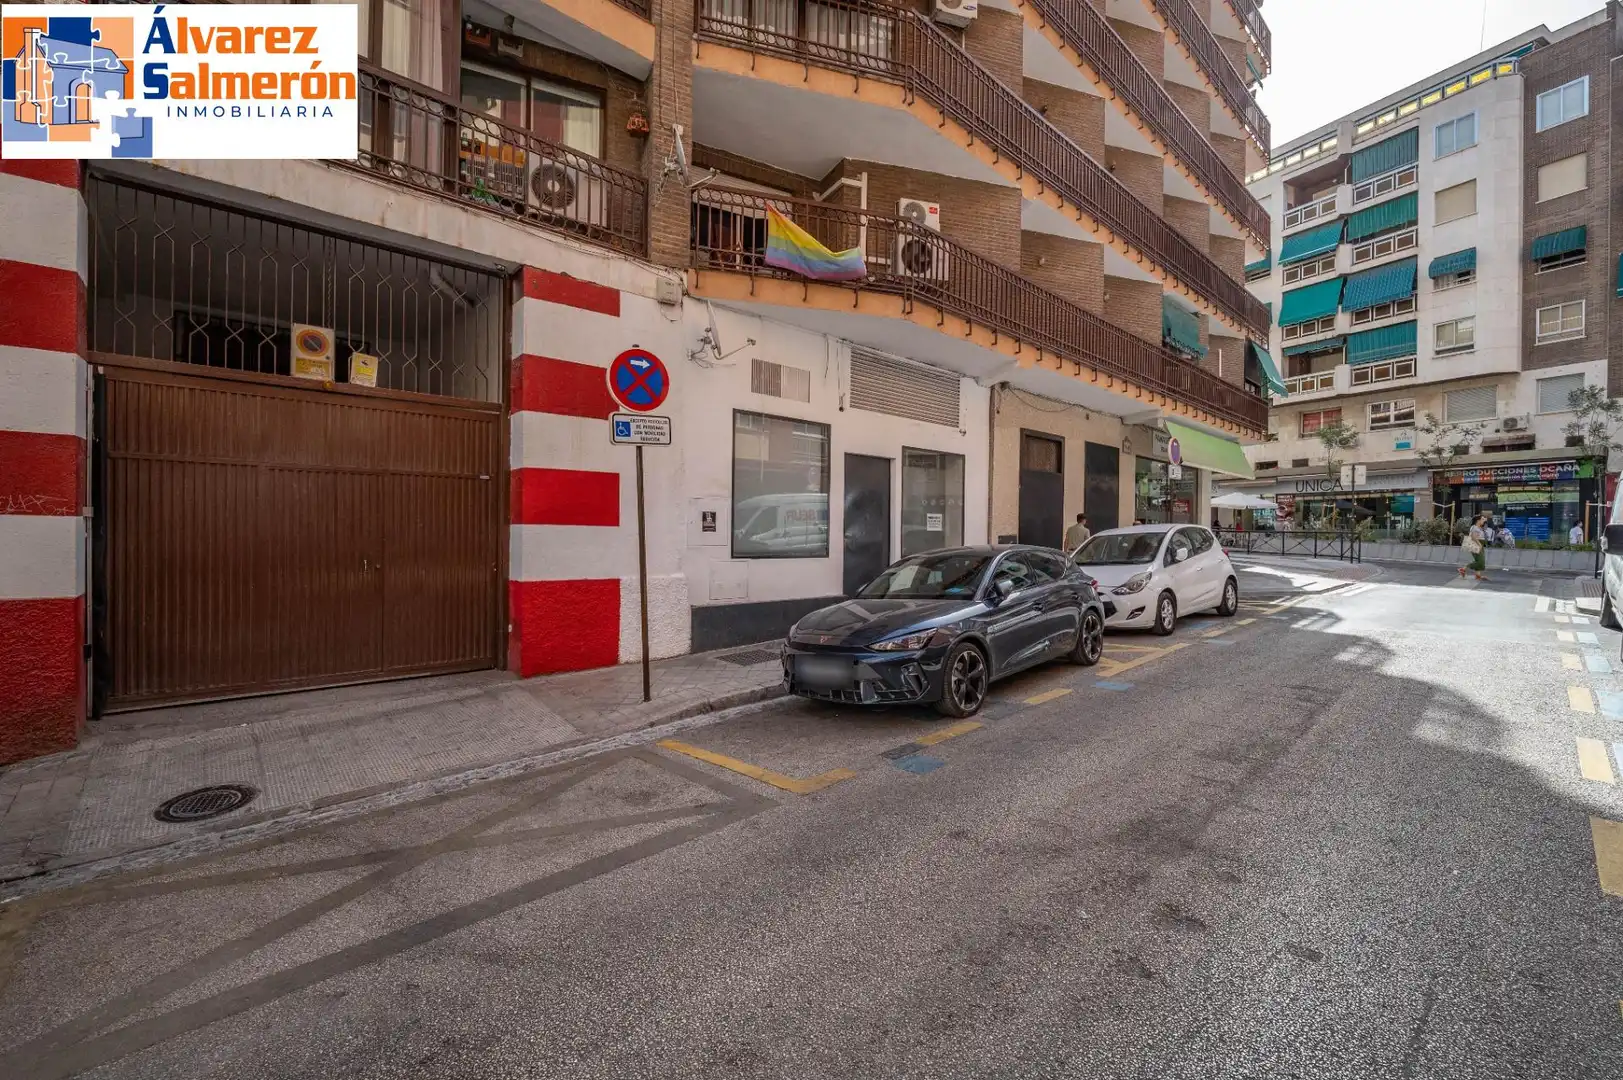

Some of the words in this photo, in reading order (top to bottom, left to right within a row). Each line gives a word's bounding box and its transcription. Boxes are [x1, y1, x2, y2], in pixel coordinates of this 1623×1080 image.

[1444, 466, 1537, 479] REPRODUCCIONES
[1540, 463, 1581, 474] OCAÑA
[1295, 478, 1344, 493] UNICA
